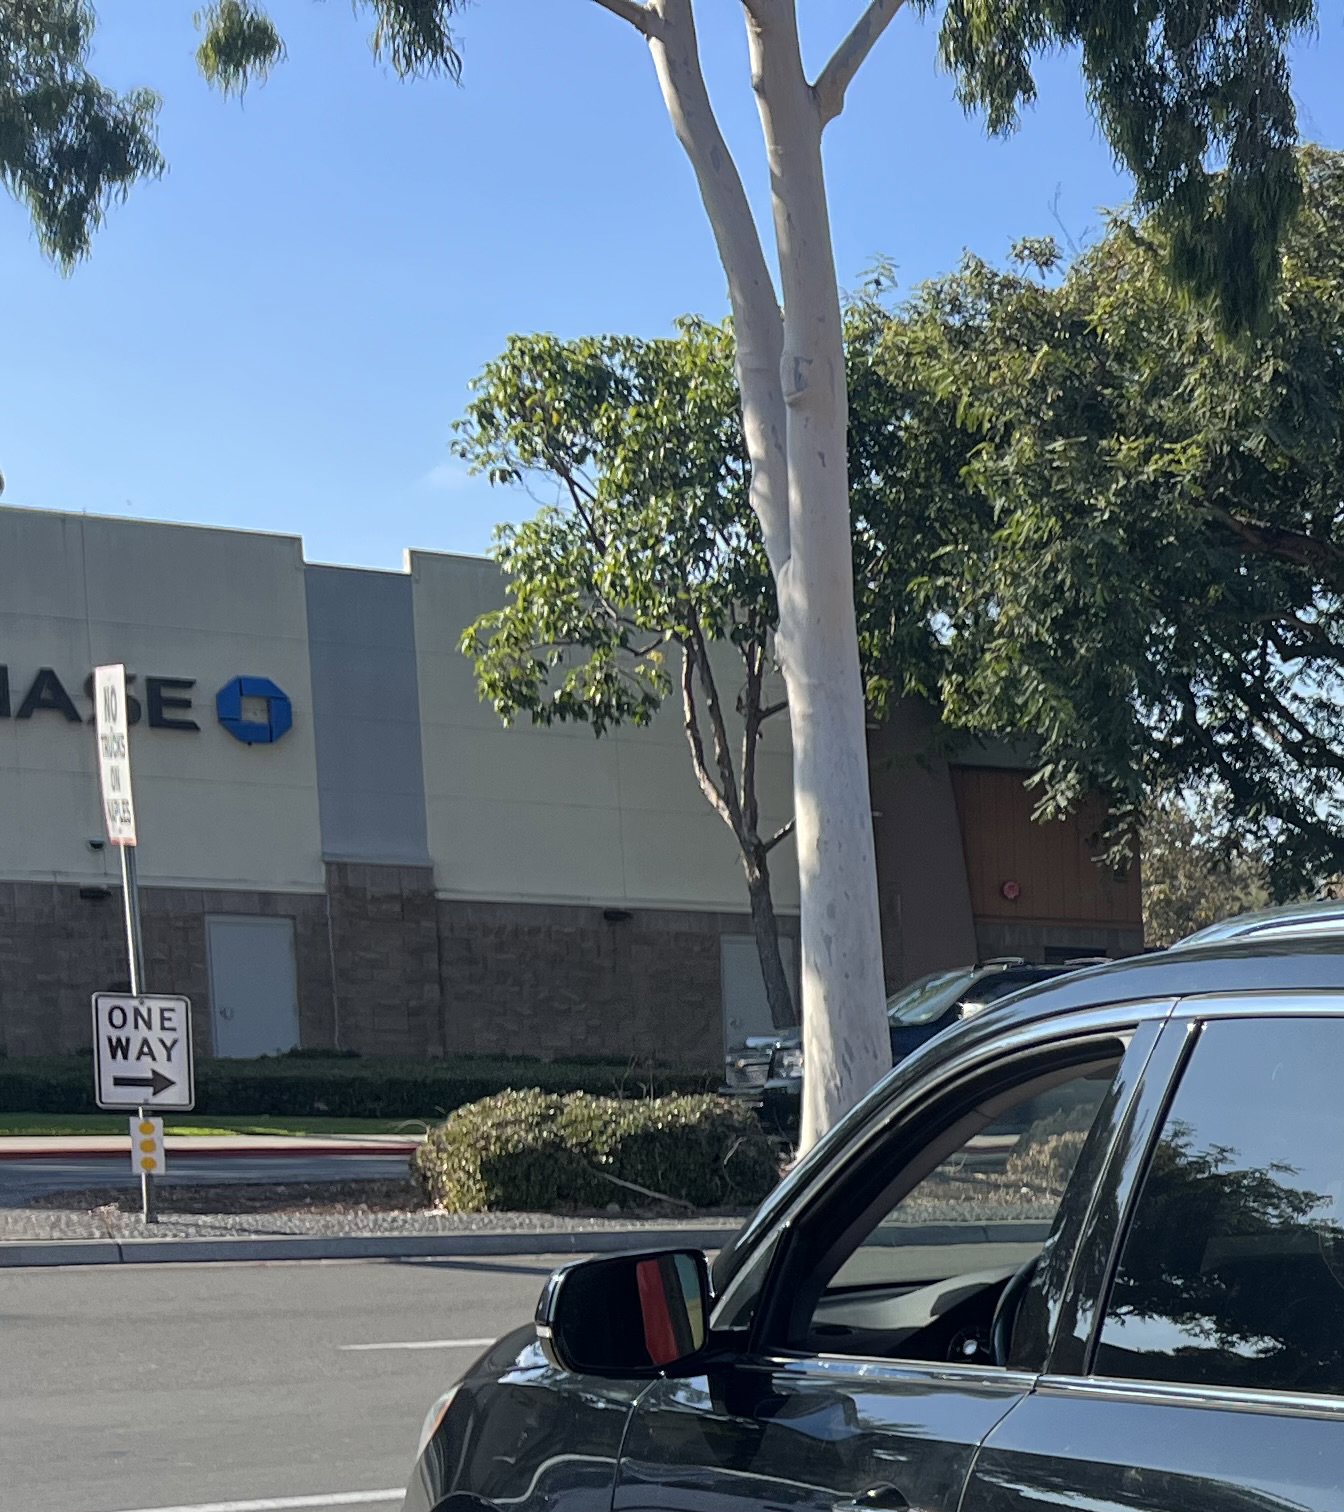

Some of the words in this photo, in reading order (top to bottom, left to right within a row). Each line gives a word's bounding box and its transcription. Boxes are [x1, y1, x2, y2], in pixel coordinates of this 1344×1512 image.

[104, 685, 118, 724] NO
[107, 1005, 177, 1032] ONE
[106, 1034, 179, 1062] WAY
